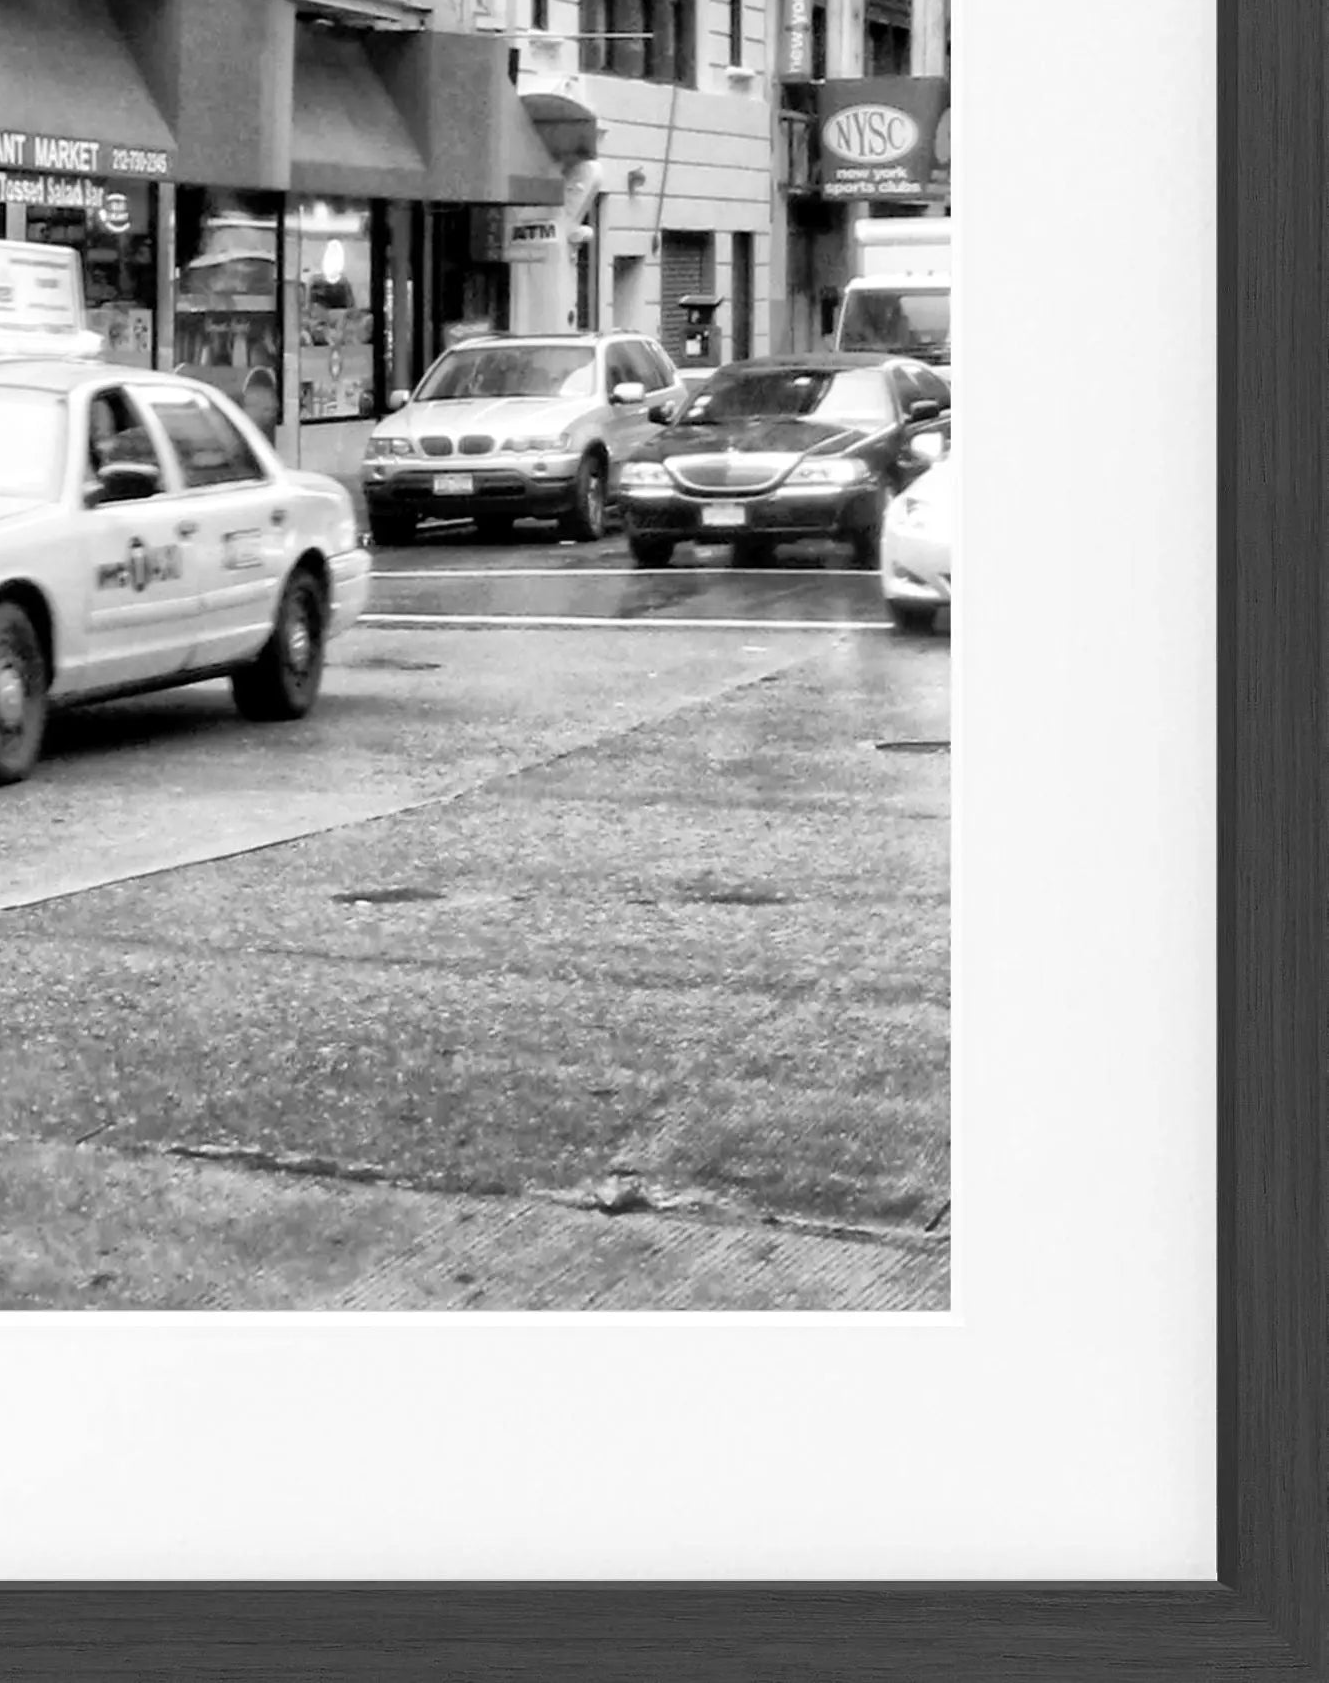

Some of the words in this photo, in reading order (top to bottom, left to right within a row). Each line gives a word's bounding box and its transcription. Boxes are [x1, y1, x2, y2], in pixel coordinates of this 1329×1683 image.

[835, 109, 906, 157] NYSC
[33, 135, 100, 172] MARKET
[835, 168, 871, 180] new
[872, 166, 909, 182] york
[46, 176, 84, 206] Salad
[84, 178, 104, 207] Bar
[823, 180, 876, 196] sports
[877, 179, 921, 194] clubs
[511, 223, 557, 241] ATM
